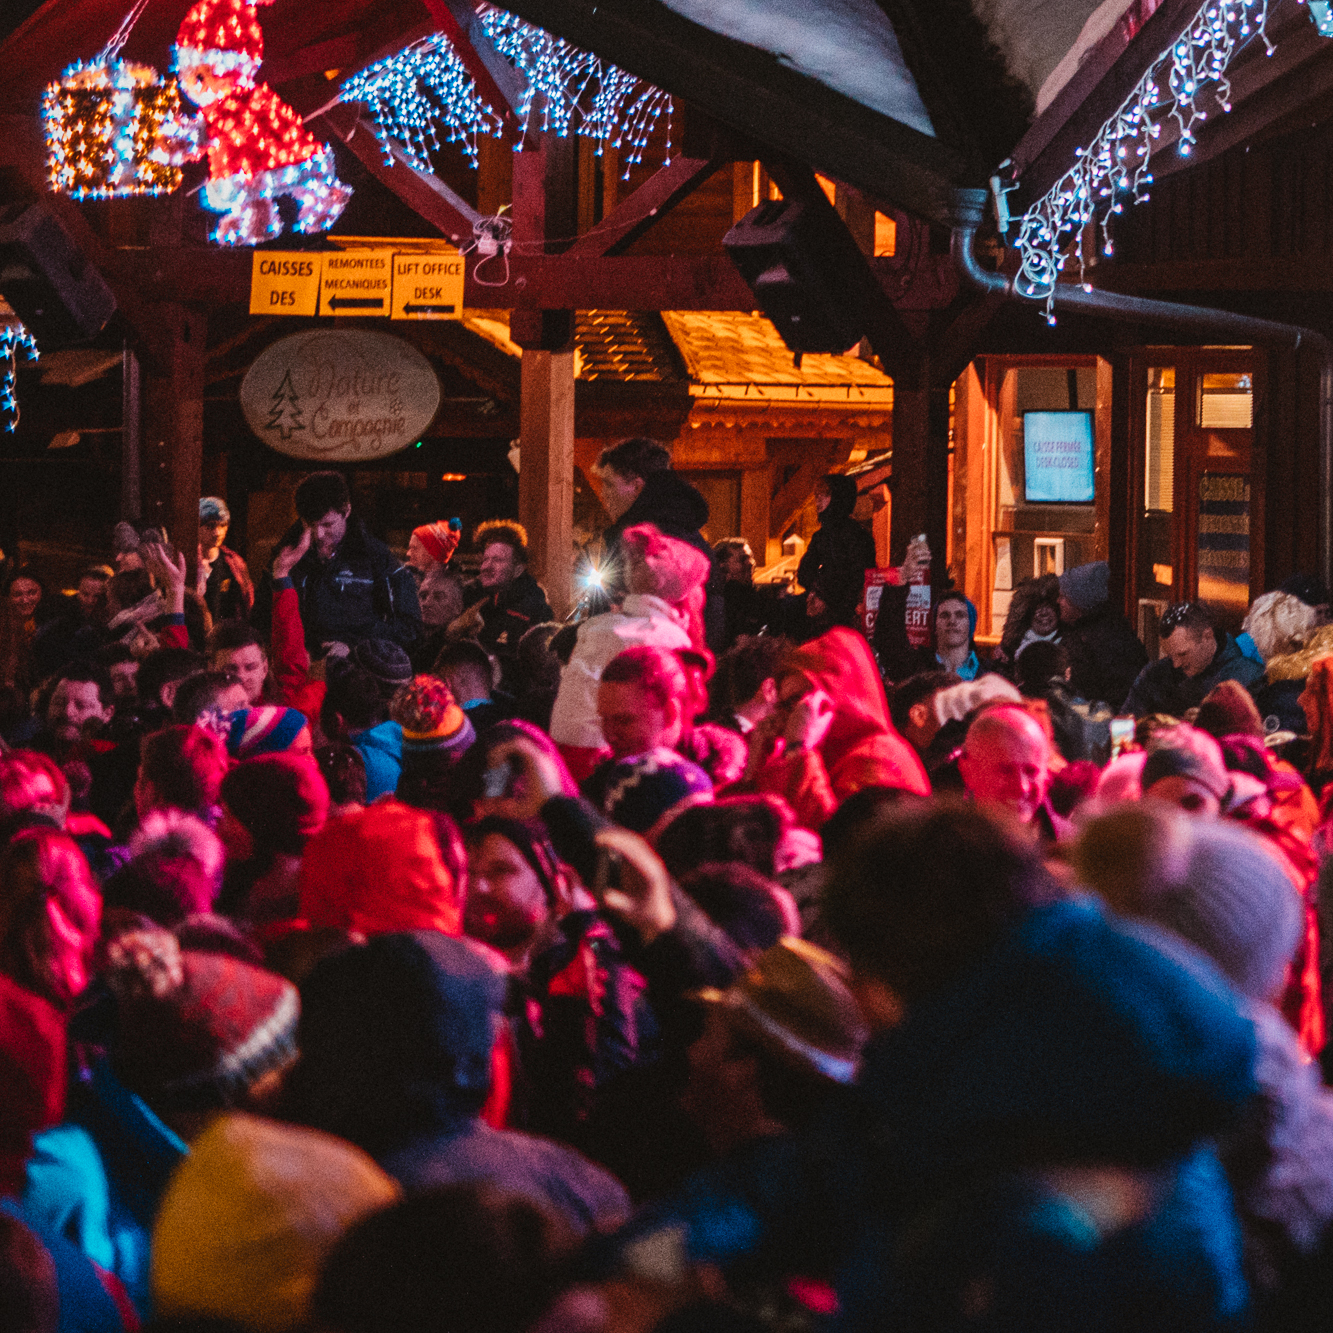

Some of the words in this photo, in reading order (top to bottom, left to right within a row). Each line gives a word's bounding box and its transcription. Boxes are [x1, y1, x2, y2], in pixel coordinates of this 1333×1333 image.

[259, 260, 313, 276] CAISSES
[328, 258, 386, 270] REMONTEES
[397, 262, 420, 275] LIFT
[422, 263, 461, 276] OFFICE
[324, 278, 388, 291] MECANIQUES
[269, 290, 296, 306] DES
[414, 287, 443, 300] DESK
[307, 358, 401, 398] Nature
